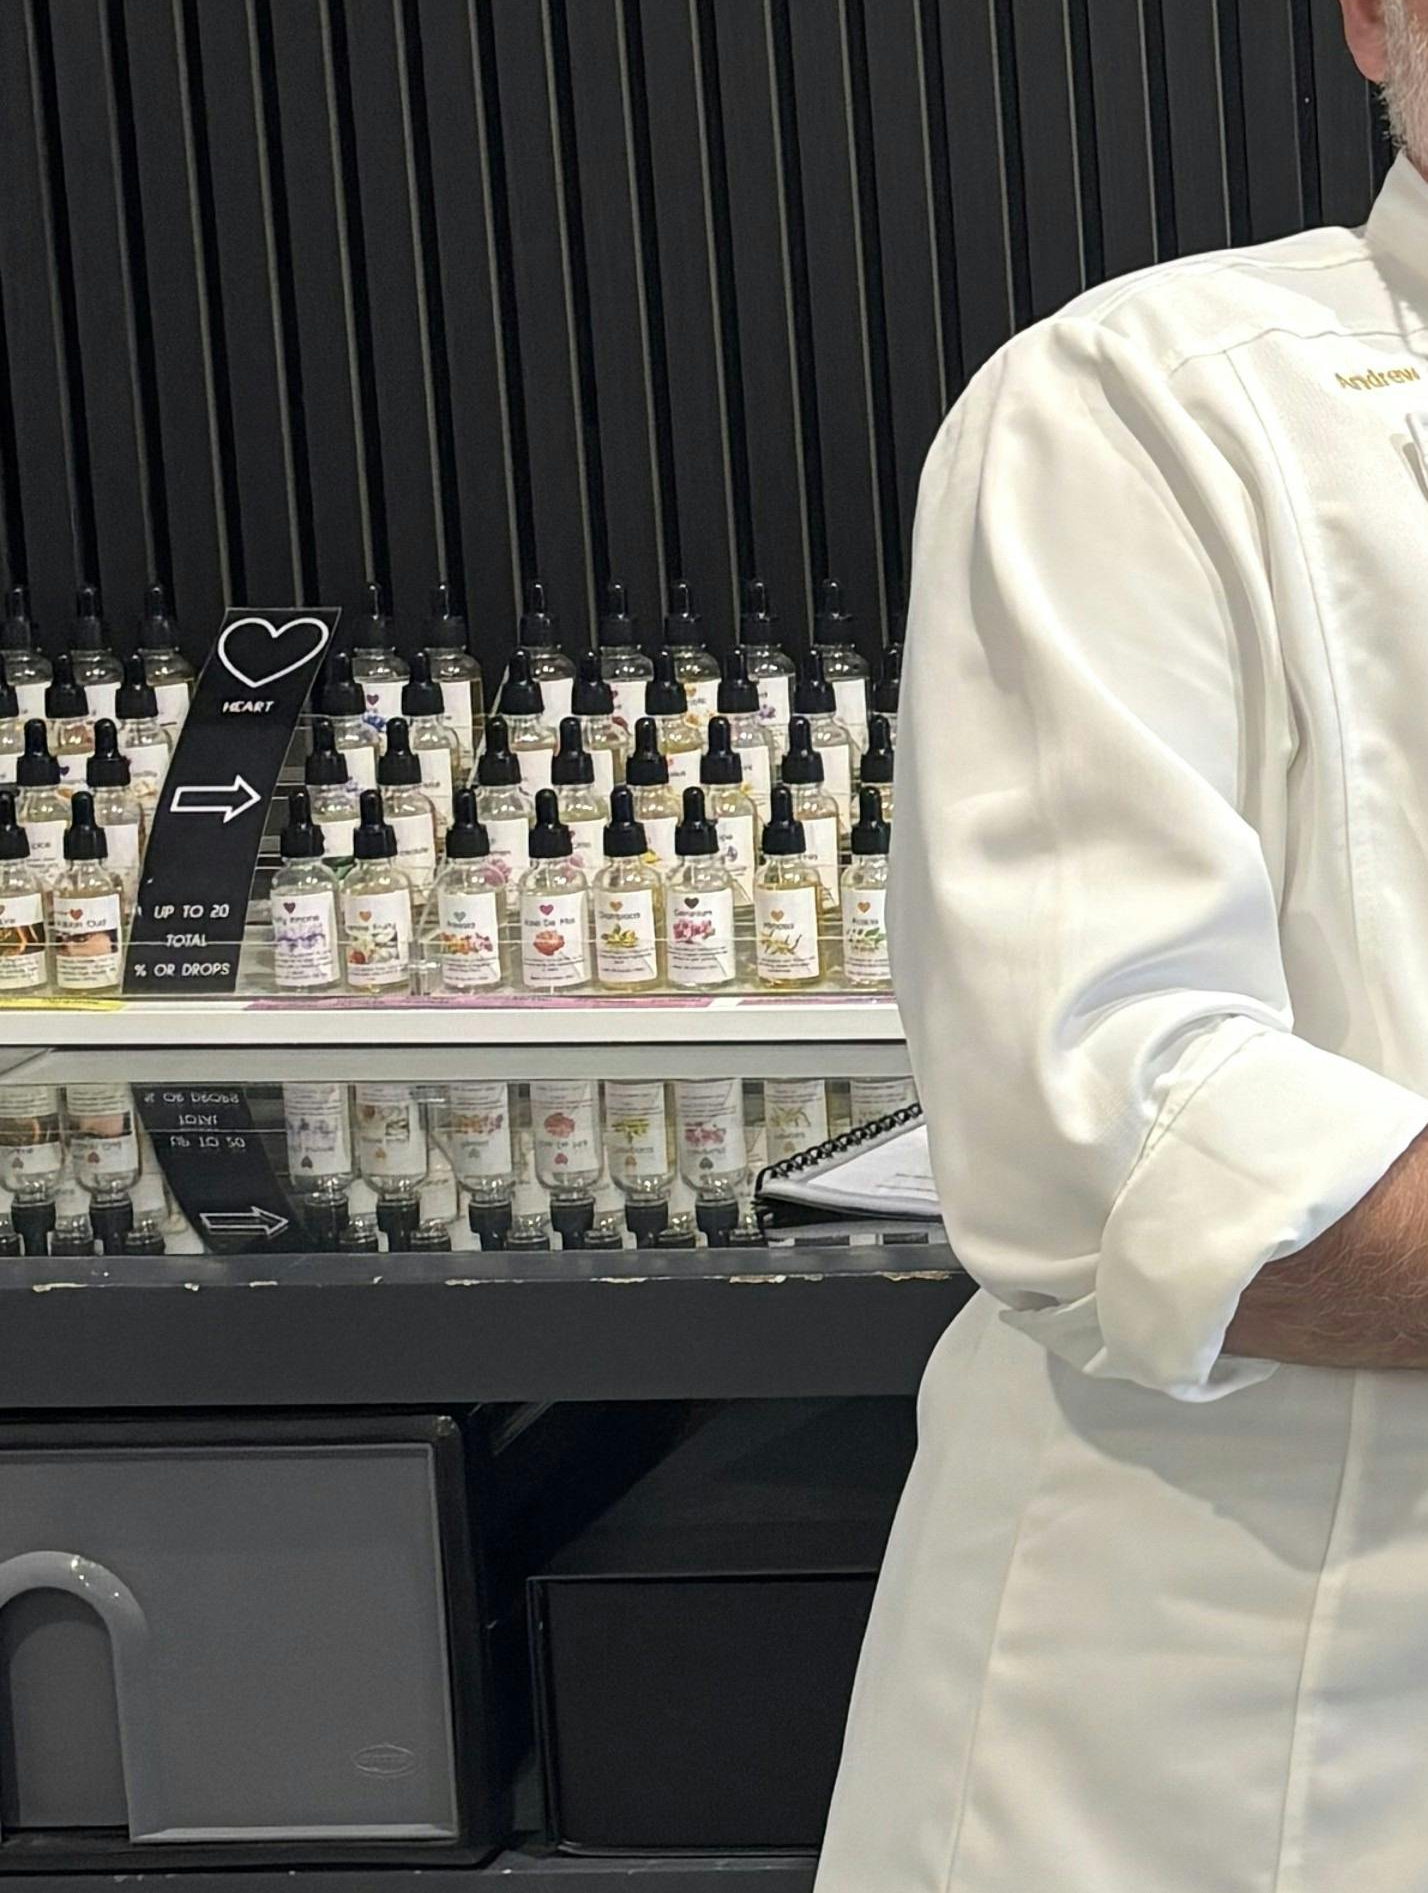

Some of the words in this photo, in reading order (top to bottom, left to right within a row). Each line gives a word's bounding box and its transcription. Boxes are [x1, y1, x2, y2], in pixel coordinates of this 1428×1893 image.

[1334, 366, 1421, 390] Andrew
[222, 700, 275, 713] HEART
[154, 905, 175, 919] UP
[183, 904, 204, 919] TO
[210, 903, 230, 918] 20
[166, 933, 208, 948] TOTAL
[134, 963, 147, 978] %
[153, 962, 176, 977] OR
[181, 961, 231, 977] DROPS
